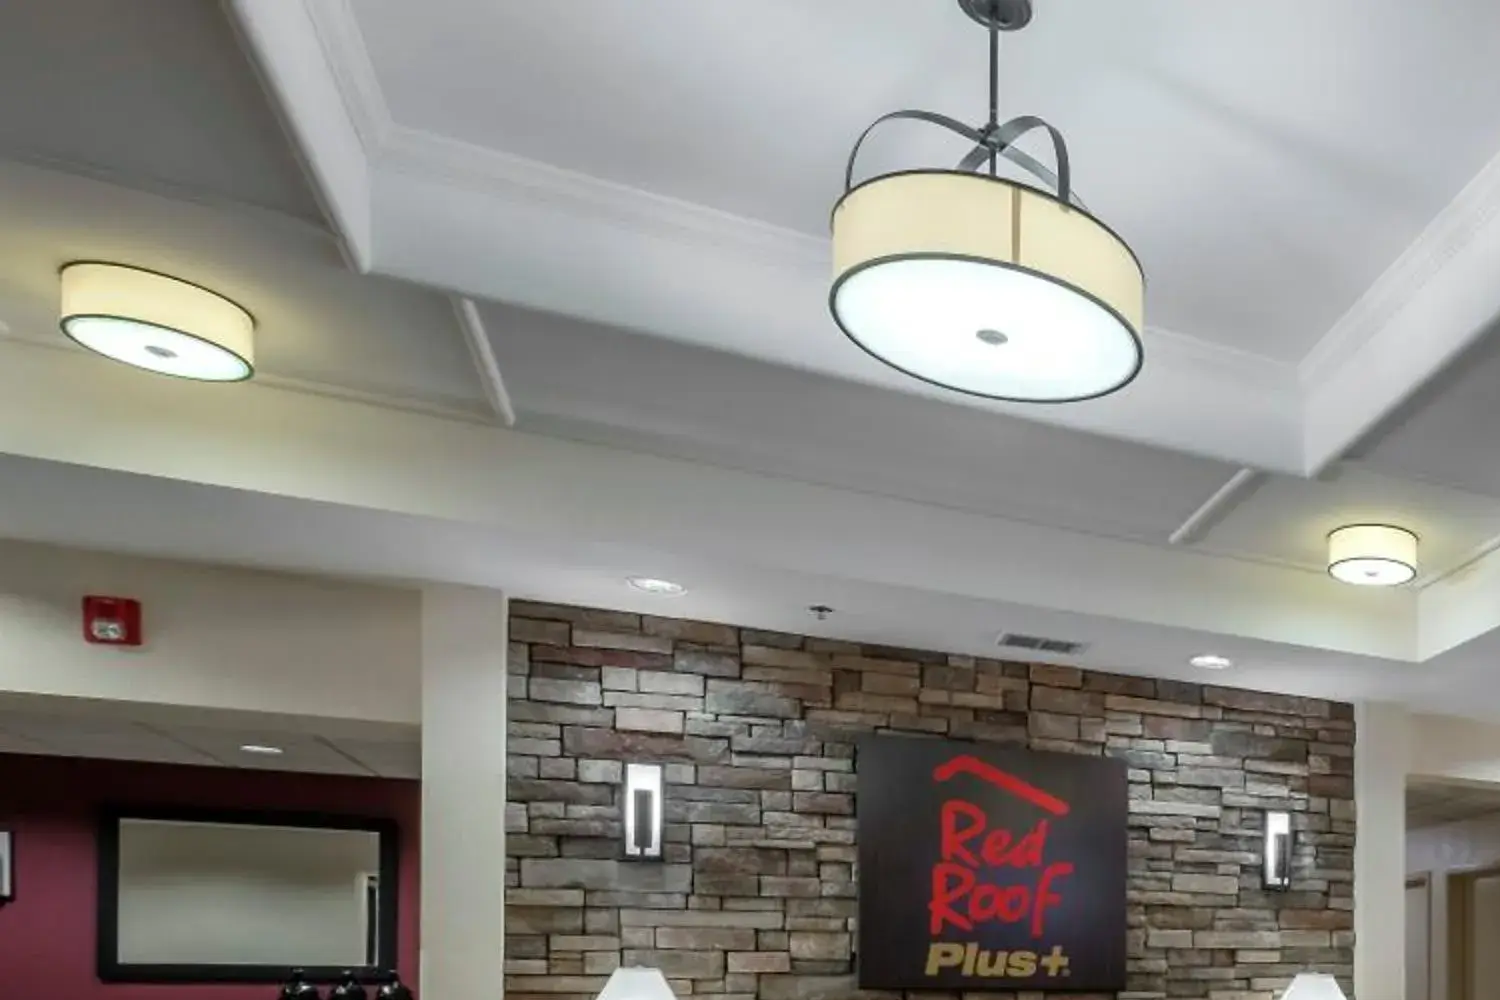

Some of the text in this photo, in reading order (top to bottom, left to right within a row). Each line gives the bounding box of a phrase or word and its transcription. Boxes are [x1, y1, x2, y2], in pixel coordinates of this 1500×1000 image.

[941, 799, 1048, 868] Red
[928, 862, 1074, 939] Roof
[925, 941, 1069, 977] Plus+
